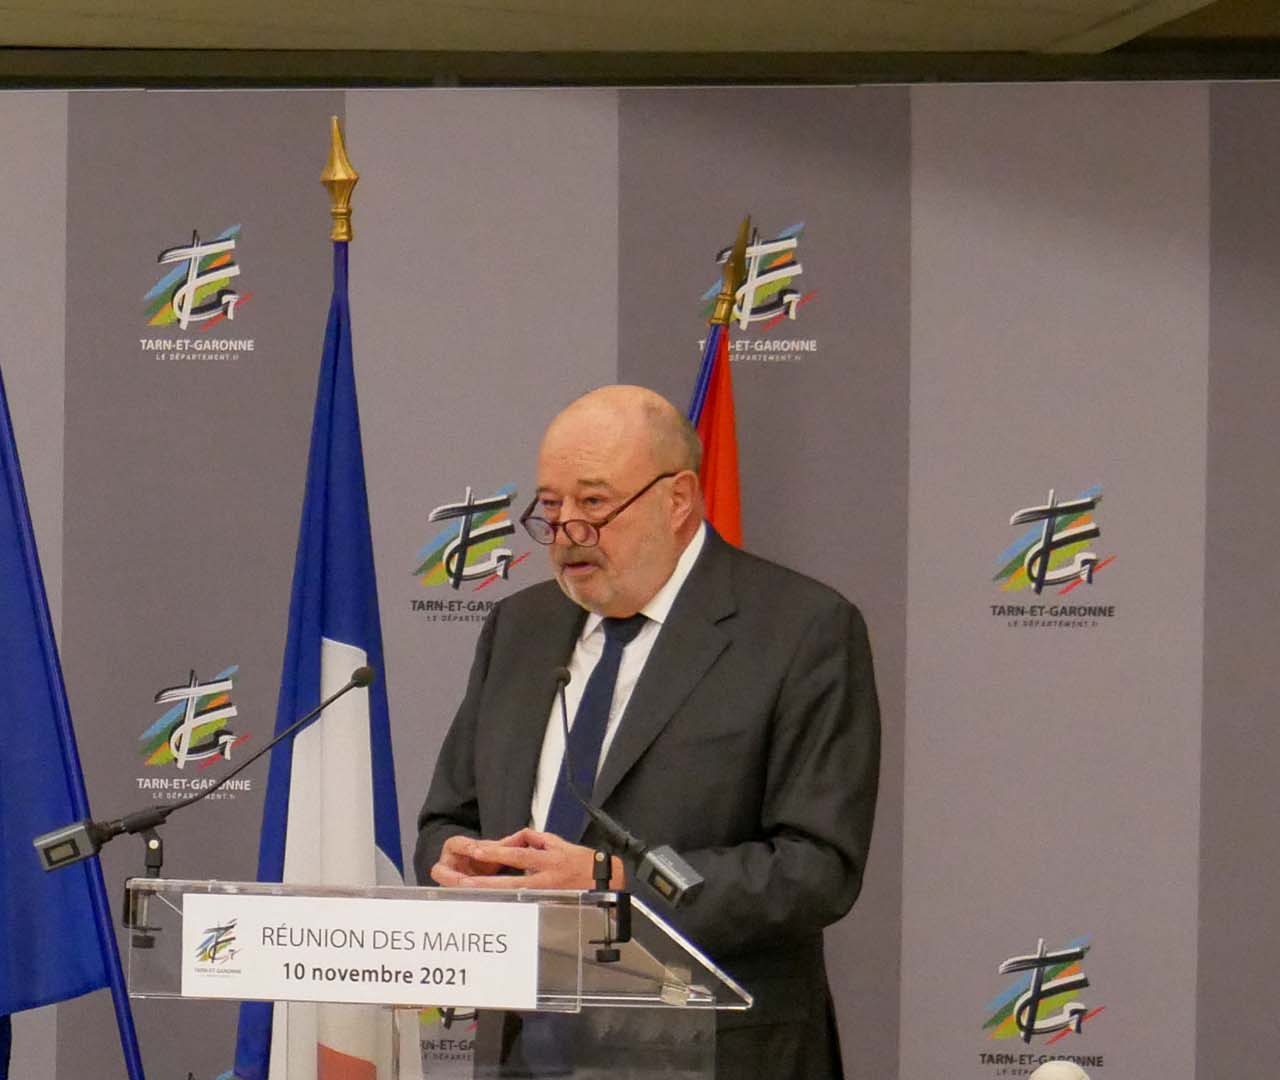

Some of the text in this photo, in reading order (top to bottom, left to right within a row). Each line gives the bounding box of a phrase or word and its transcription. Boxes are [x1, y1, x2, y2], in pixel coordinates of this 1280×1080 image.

[140, 339, 255, 351] TARN-ET-GARONNE
[990, 605, 1115, 617] TARN-ET-GARONNE
[261, 923, 508, 954] RÉUNION DES MAIRES
[282, 962, 468, 986] 10 novembre 2021
